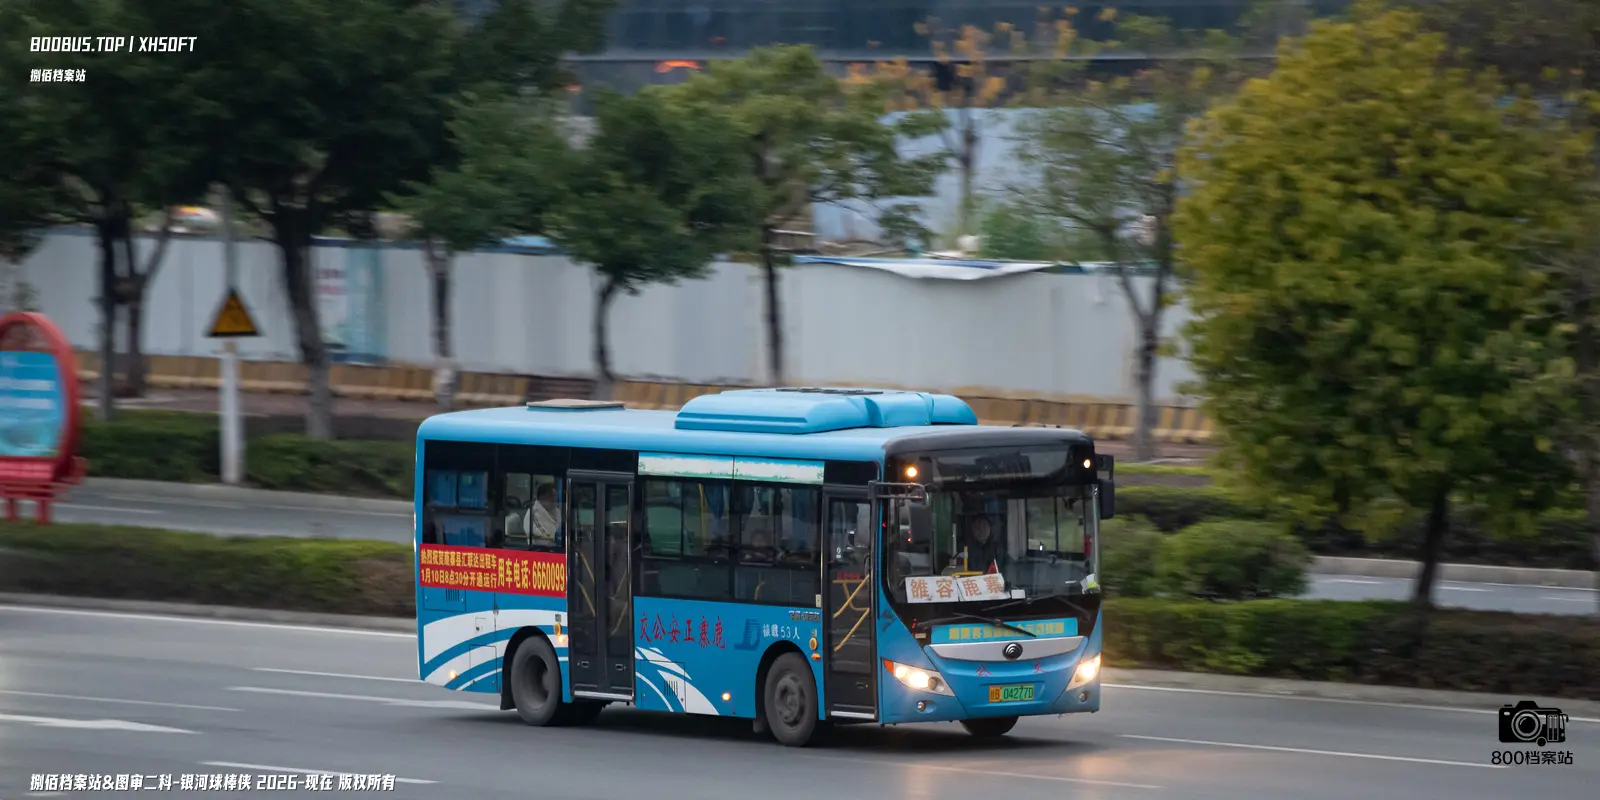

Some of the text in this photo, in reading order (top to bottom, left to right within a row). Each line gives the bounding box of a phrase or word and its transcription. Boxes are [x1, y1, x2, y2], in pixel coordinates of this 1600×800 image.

[421, 567, 498, 589] 1月10日8点30分开通运行
